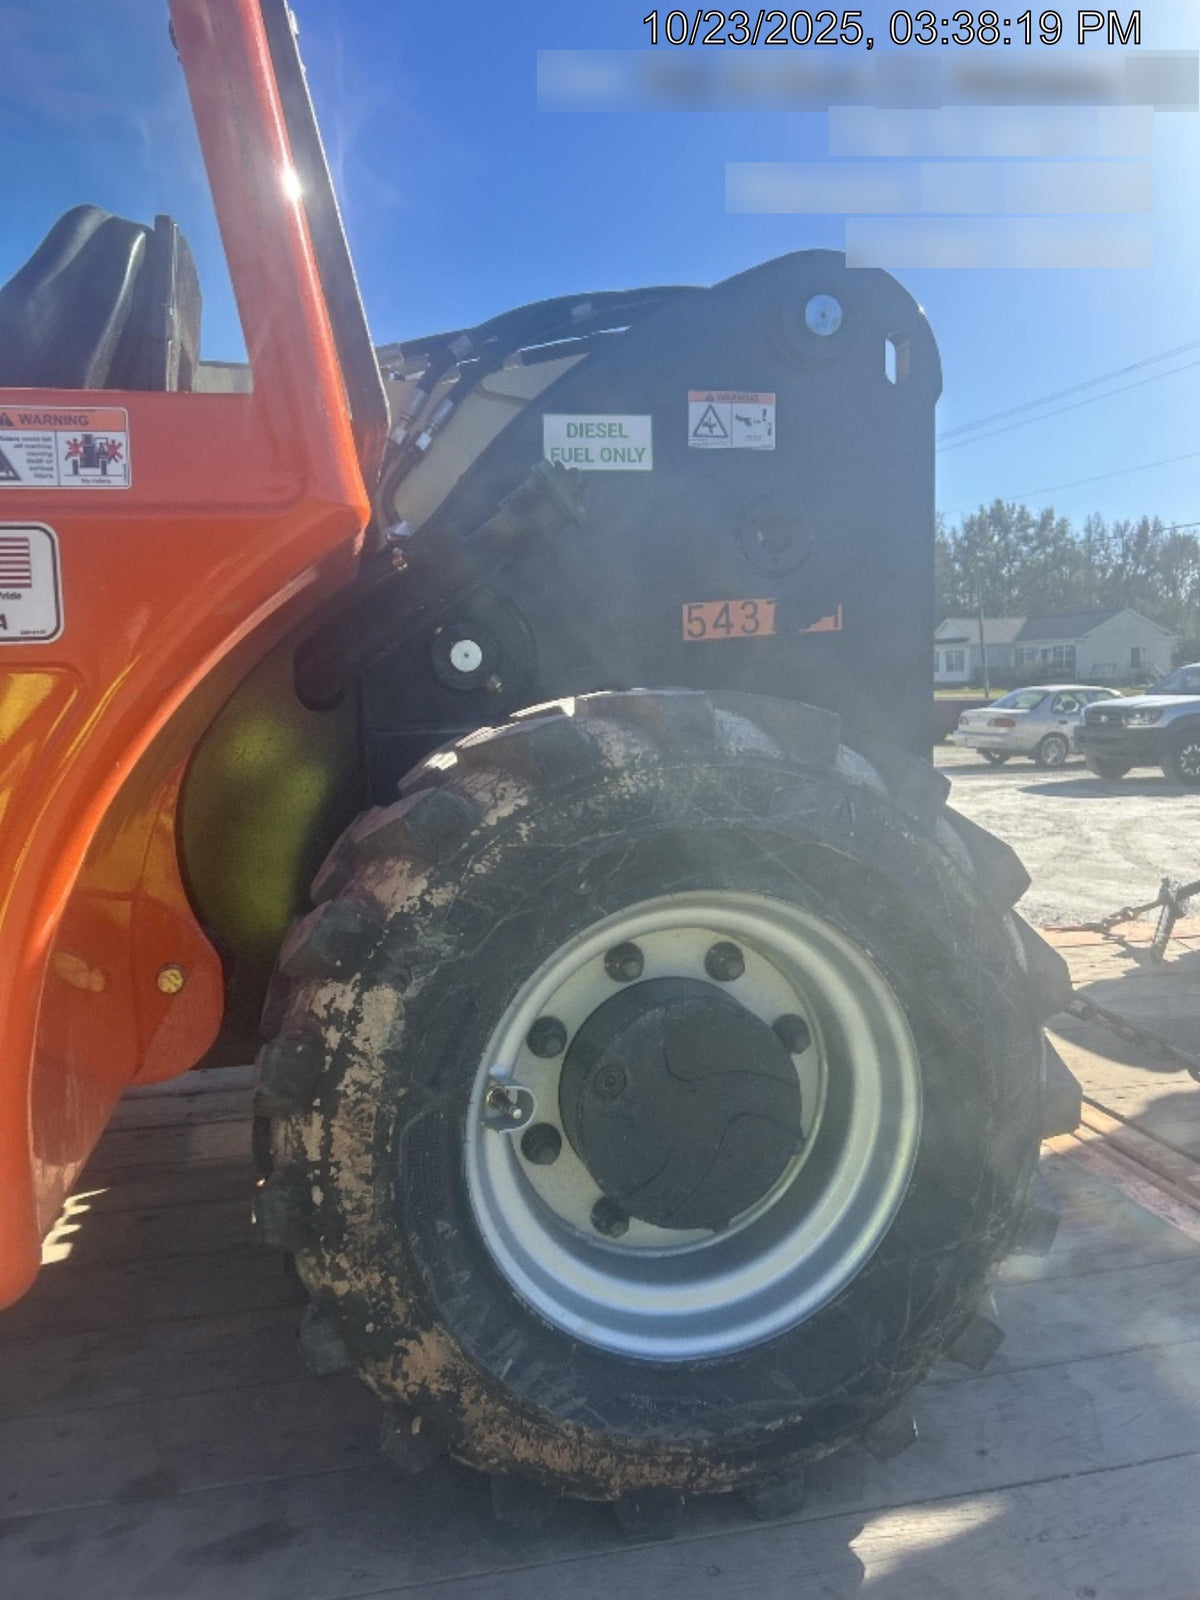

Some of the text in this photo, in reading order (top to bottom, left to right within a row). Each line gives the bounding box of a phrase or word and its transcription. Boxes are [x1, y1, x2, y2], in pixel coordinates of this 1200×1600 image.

[18, 414, 89, 426] WARNING
[566, 423, 629, 438] DIESEL
[550, 447, 646, 463] FUEL ONLY
[687, 601, 776, 637] 543
